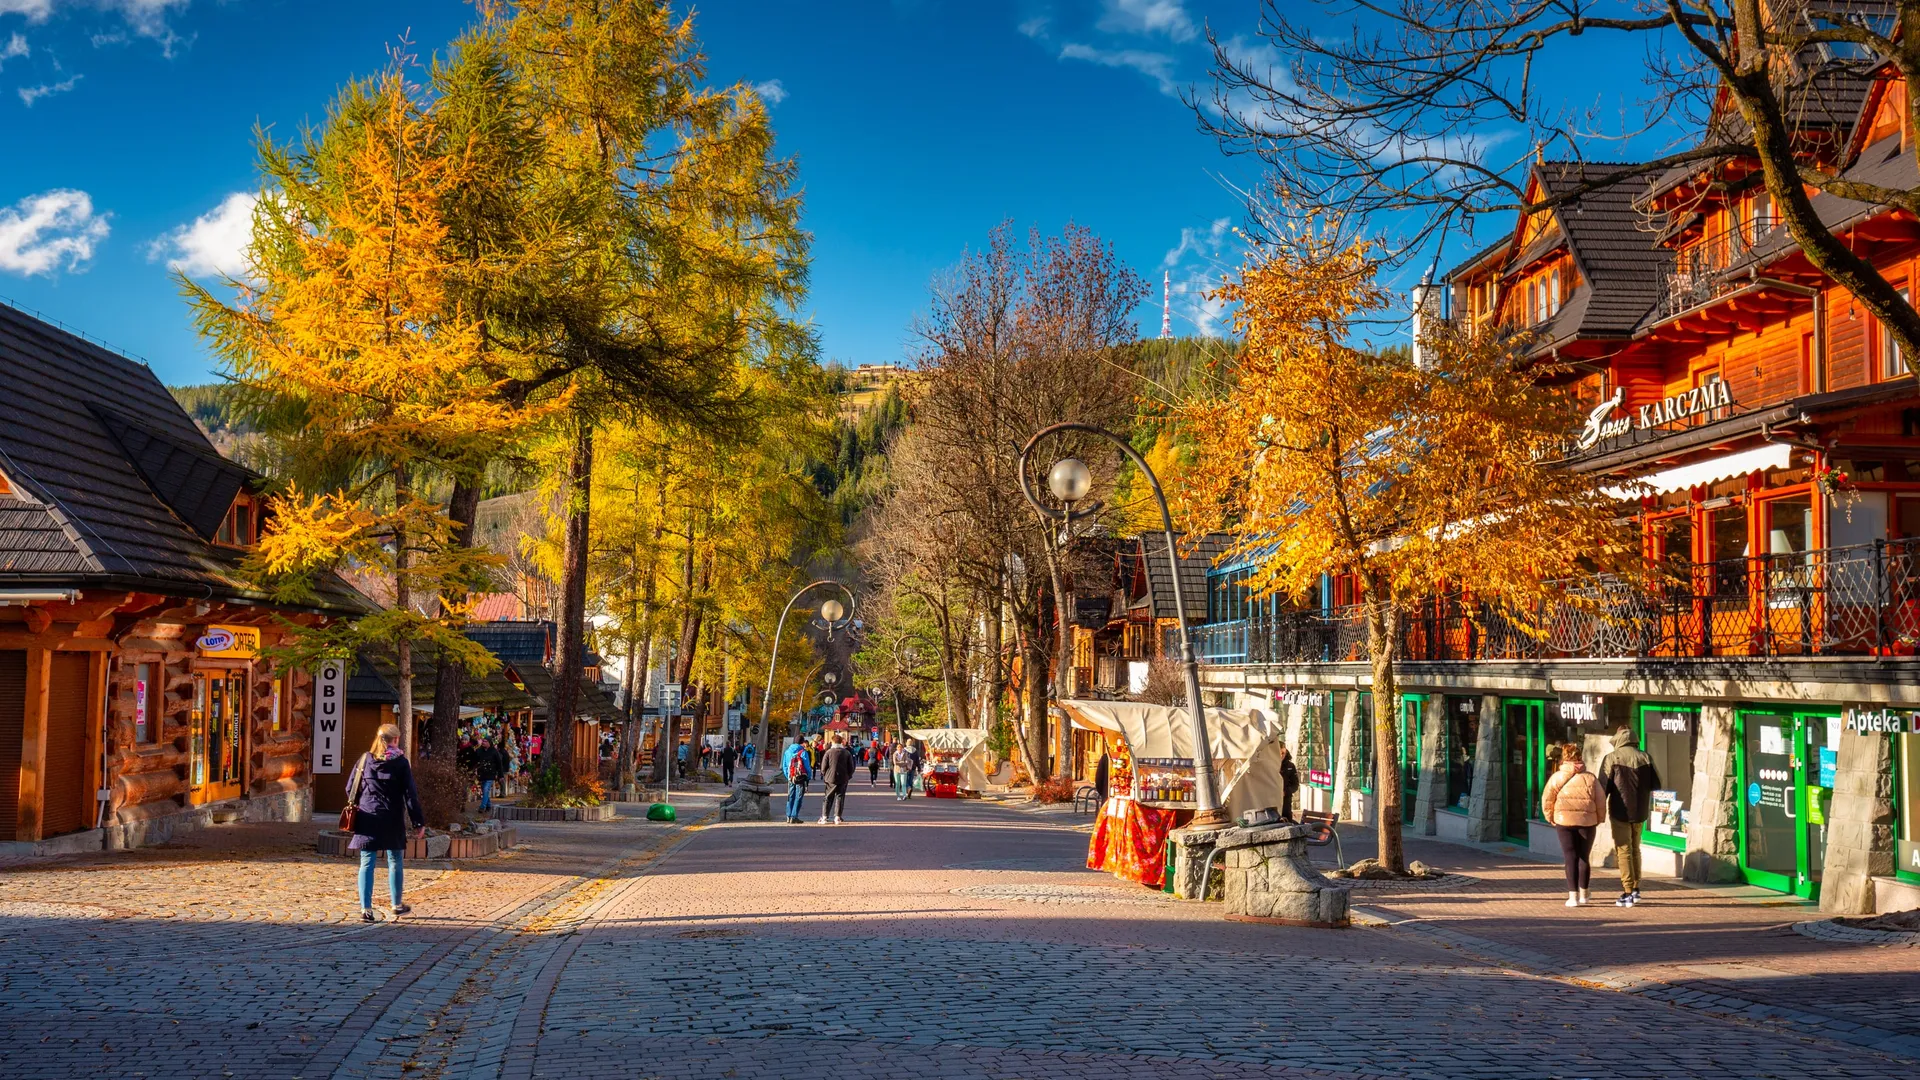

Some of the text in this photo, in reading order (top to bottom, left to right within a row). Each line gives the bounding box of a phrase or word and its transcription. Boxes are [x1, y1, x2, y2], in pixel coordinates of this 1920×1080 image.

[1639, 380, 1732, 430] KARCZMA
[205, 636, 225, 646] LOTTO
[320, 667, 337, 767] OBUWIE
[1459, 698, 1475, 714] empik
[1560, 694, 1595, 724] empik
[1661, 713, 1686, 734] empik
[1846, 708, 1901, 736] Apteka
